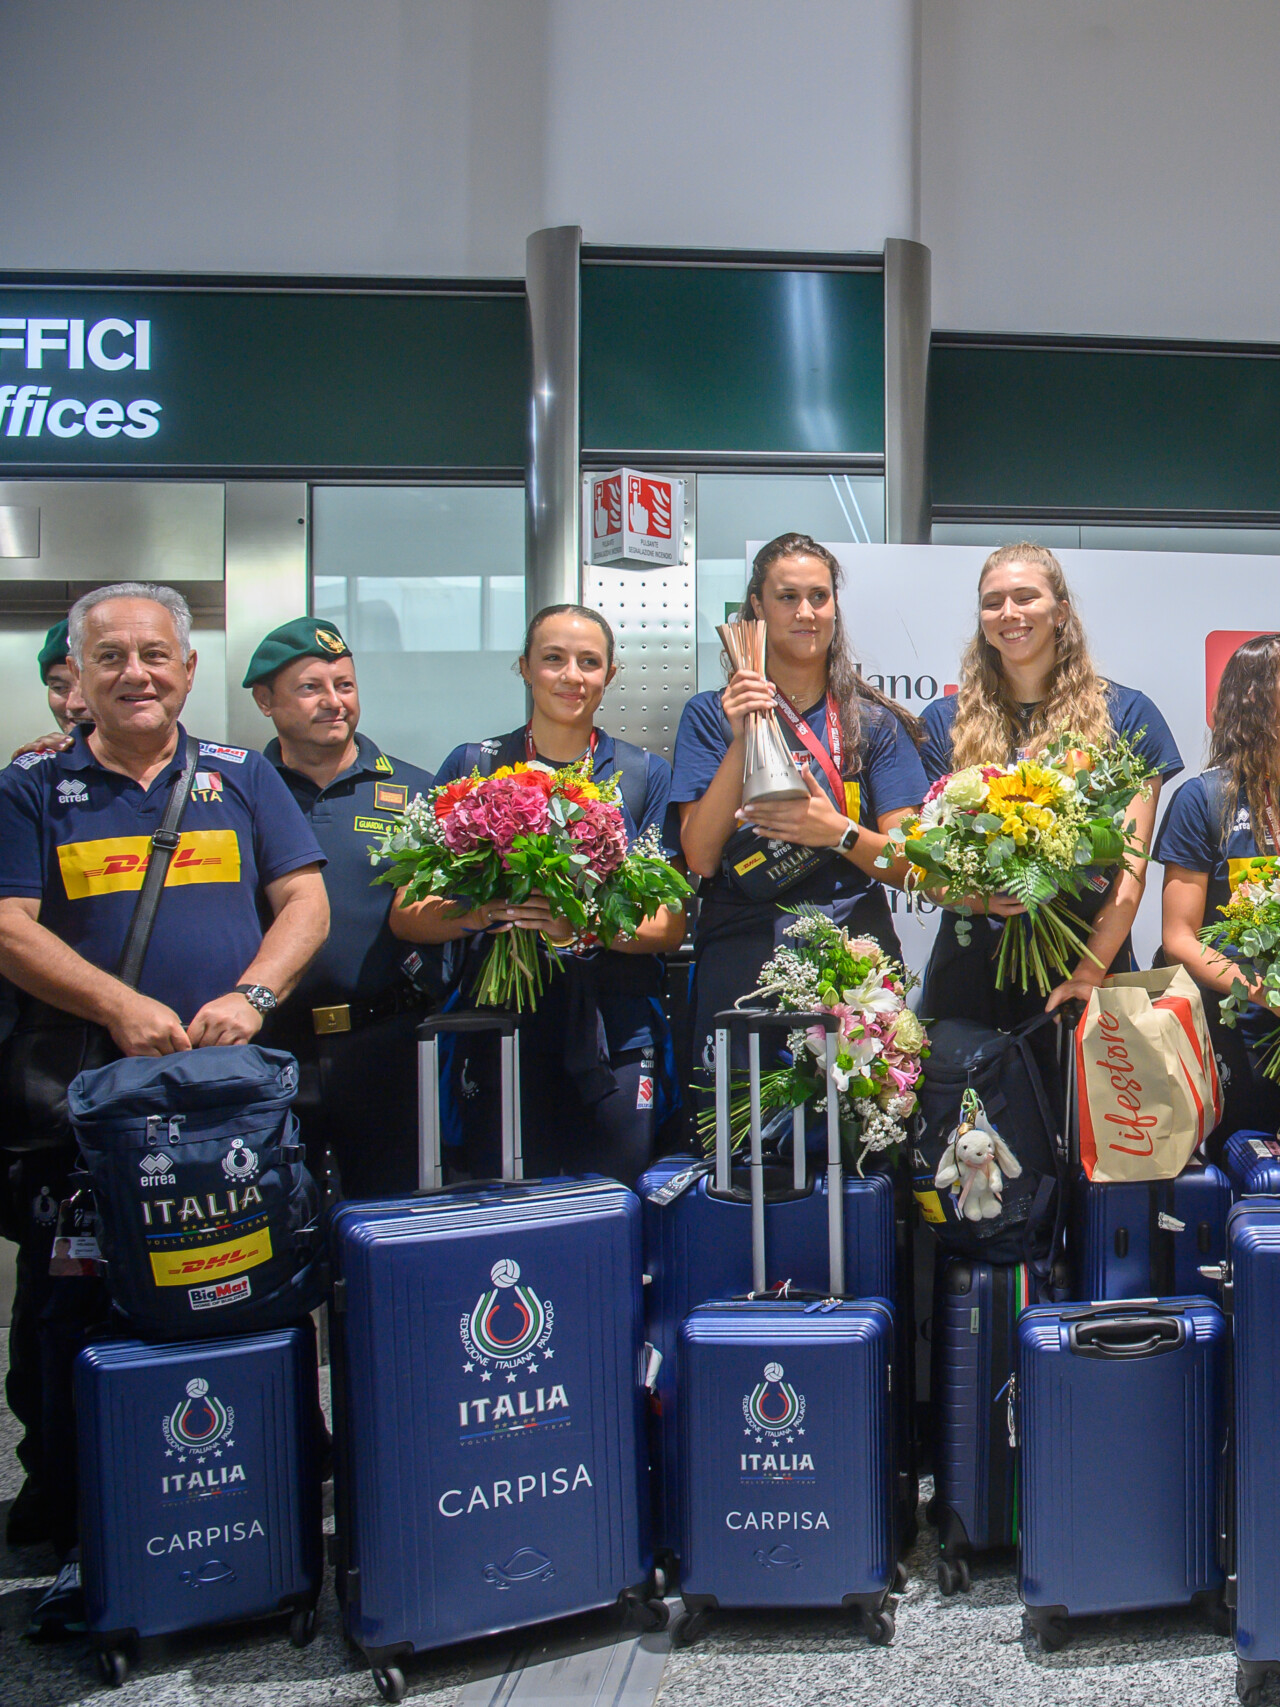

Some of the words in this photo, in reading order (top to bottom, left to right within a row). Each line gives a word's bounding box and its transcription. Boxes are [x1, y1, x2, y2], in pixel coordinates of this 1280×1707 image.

[796, 722, 809, 735] 2025
[58, 793, 89, 804] errea
[190, 789, 223, 803] ITA
[359, 820, 384, 831] GUARDIA
[772, 843, 793, 858] errea
[766, 847, 815, 880] ITALIA
[1096, 1010, 1158, 1157] Lifestore
[140, 1173, 176, 1187] errea
[140, 1185, 263, 1226] ITALIA
[181, 1249, 249, 1274] DHL
[190, 1281, 248, 1301] BigMat
[459, 1312, 490, 1367] FEDERAZIONE
[495, 1351, 537, 1370] ITALIANA
[536, 1300, 555, 1350] PALLAVOLO
[458, 1383, 570, 1427] ITALIA
[764, 1428, 793, 1438] ITALIANA
[189, 1441, 221, 1455] ITALIANA
[740, 1454, 815, 1471] ITALIA
[161, 1464, 247, 1494] ITALIA
[438, 1463, 593, 1518] CARPISA
[726, 1511, 830, 1530] CARPISA
[146, 1519, 265, 1556] CARPISA
